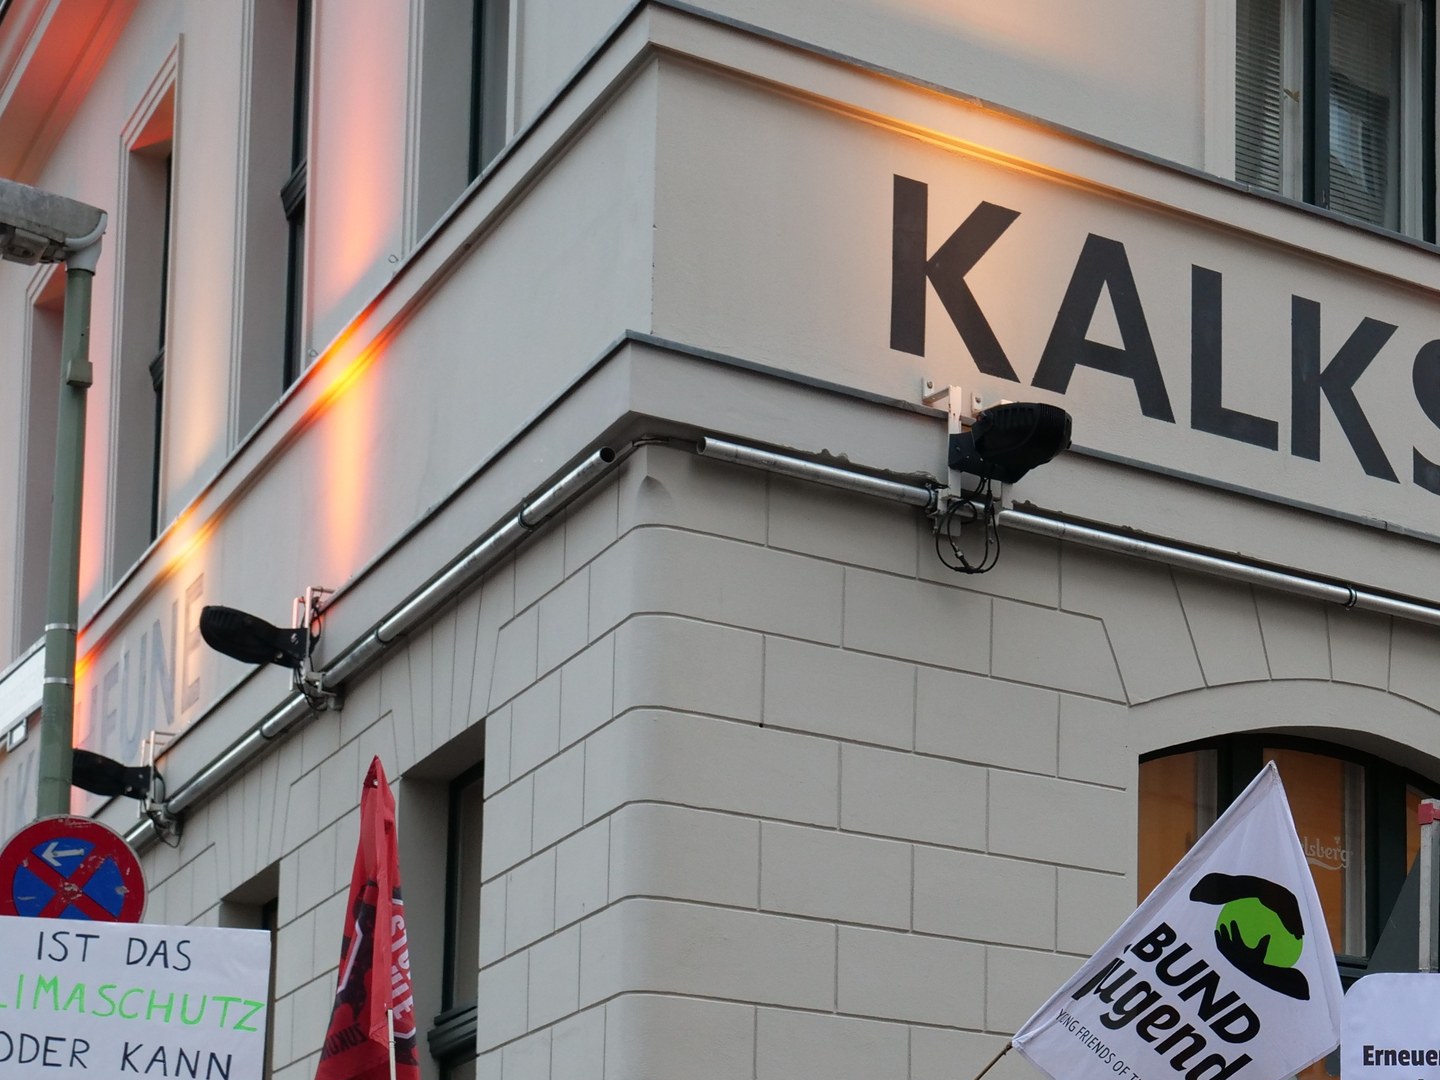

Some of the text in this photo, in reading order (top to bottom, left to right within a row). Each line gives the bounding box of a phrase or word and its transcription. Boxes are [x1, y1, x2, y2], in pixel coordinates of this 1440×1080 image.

[37, 931, 192, 972] IST DAS
[1130, 922, 1261, 1046] BUND
[1076, 1024, 1117, 1065] FRIENDS
[1113, 1060, 1131, 1078] OF
